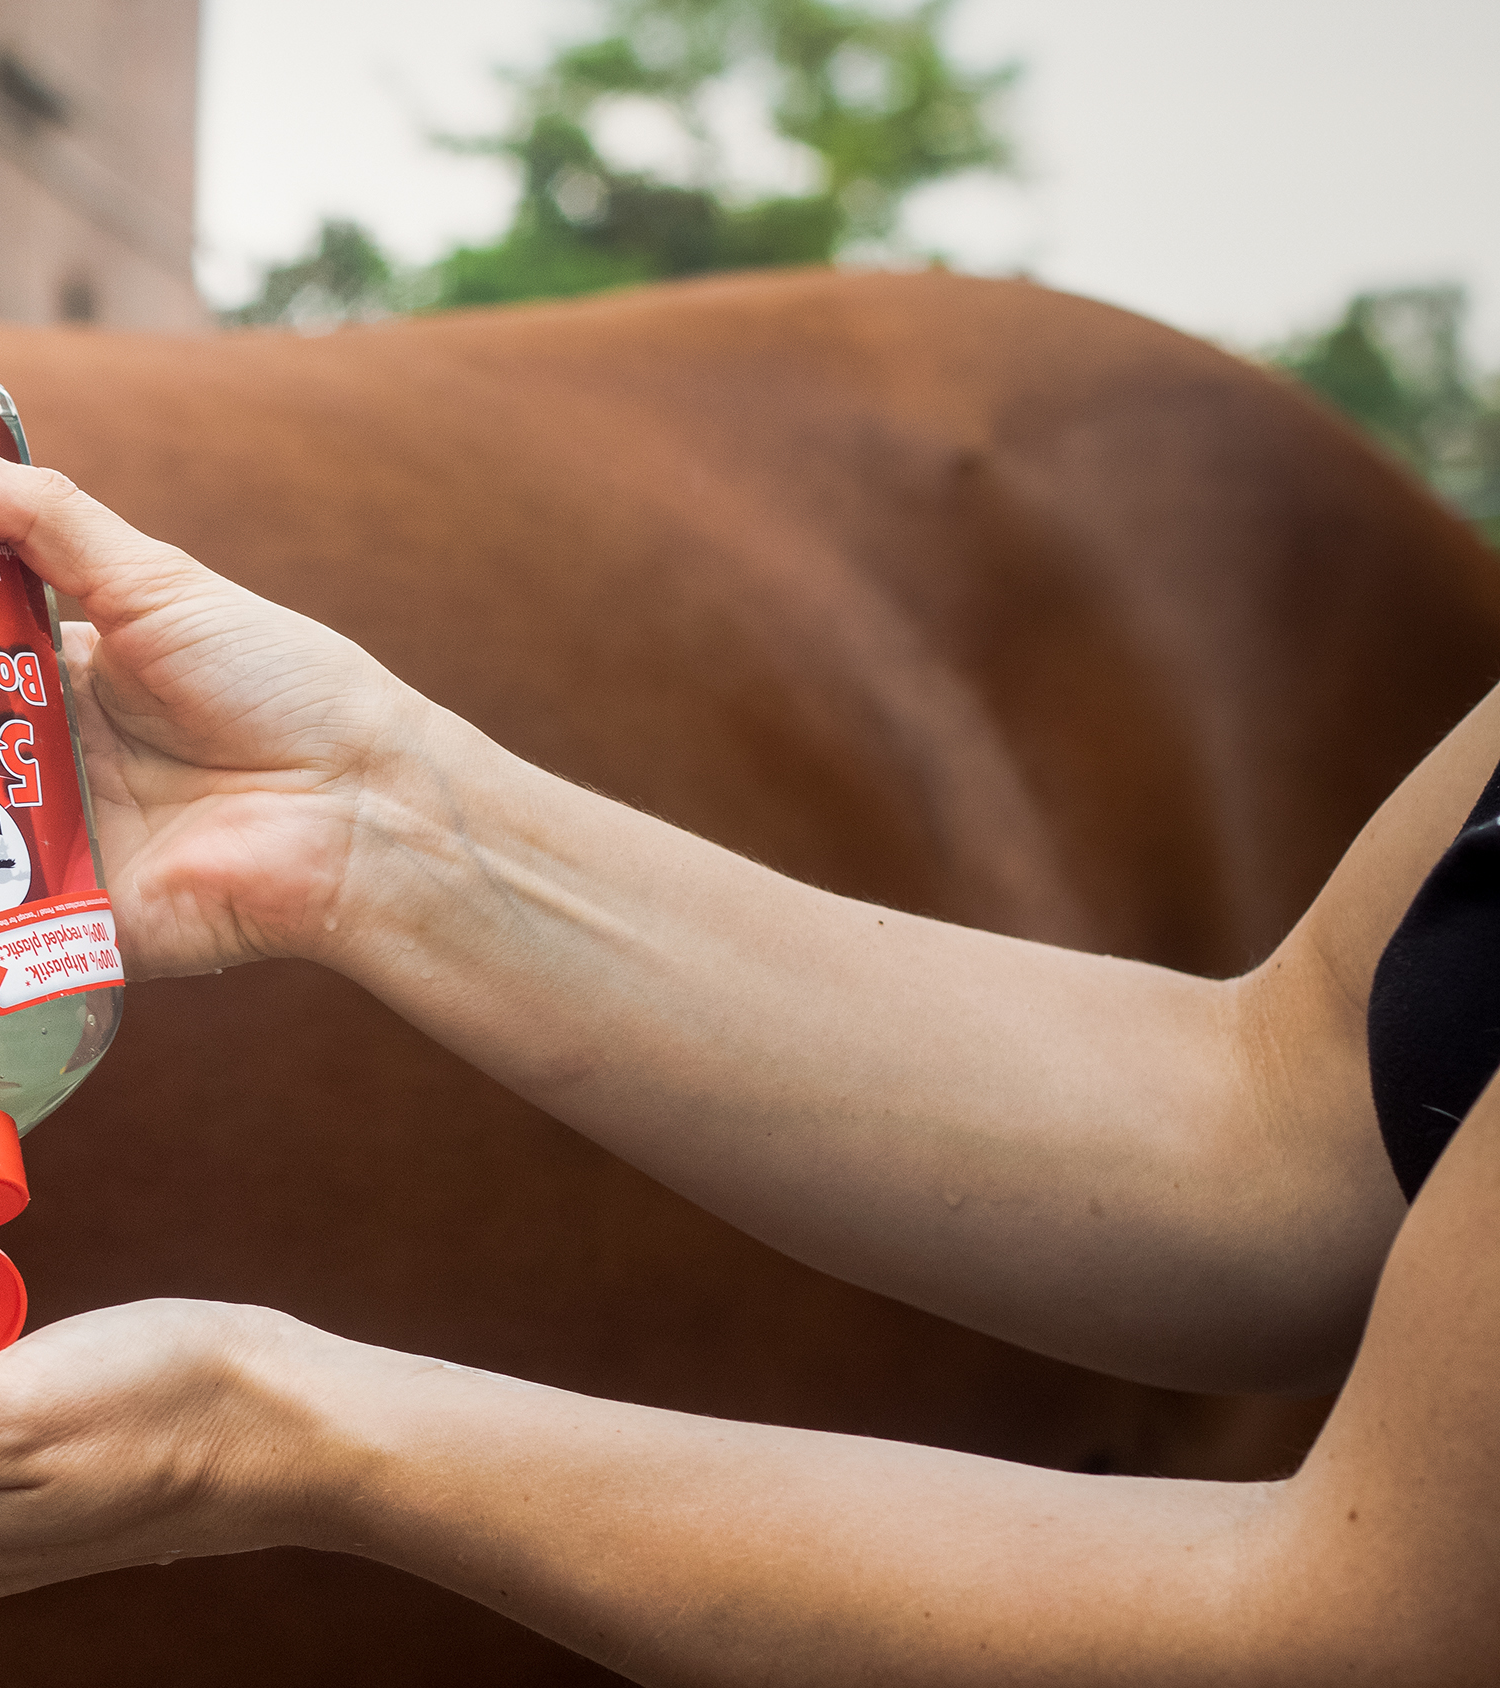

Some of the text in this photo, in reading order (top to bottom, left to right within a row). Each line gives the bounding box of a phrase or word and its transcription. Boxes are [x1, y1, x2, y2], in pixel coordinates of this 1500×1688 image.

[41, 924, 82, 952] recycled
[82, 922, 109, 943] 100%
[89, 949, 118, 970] 100%
